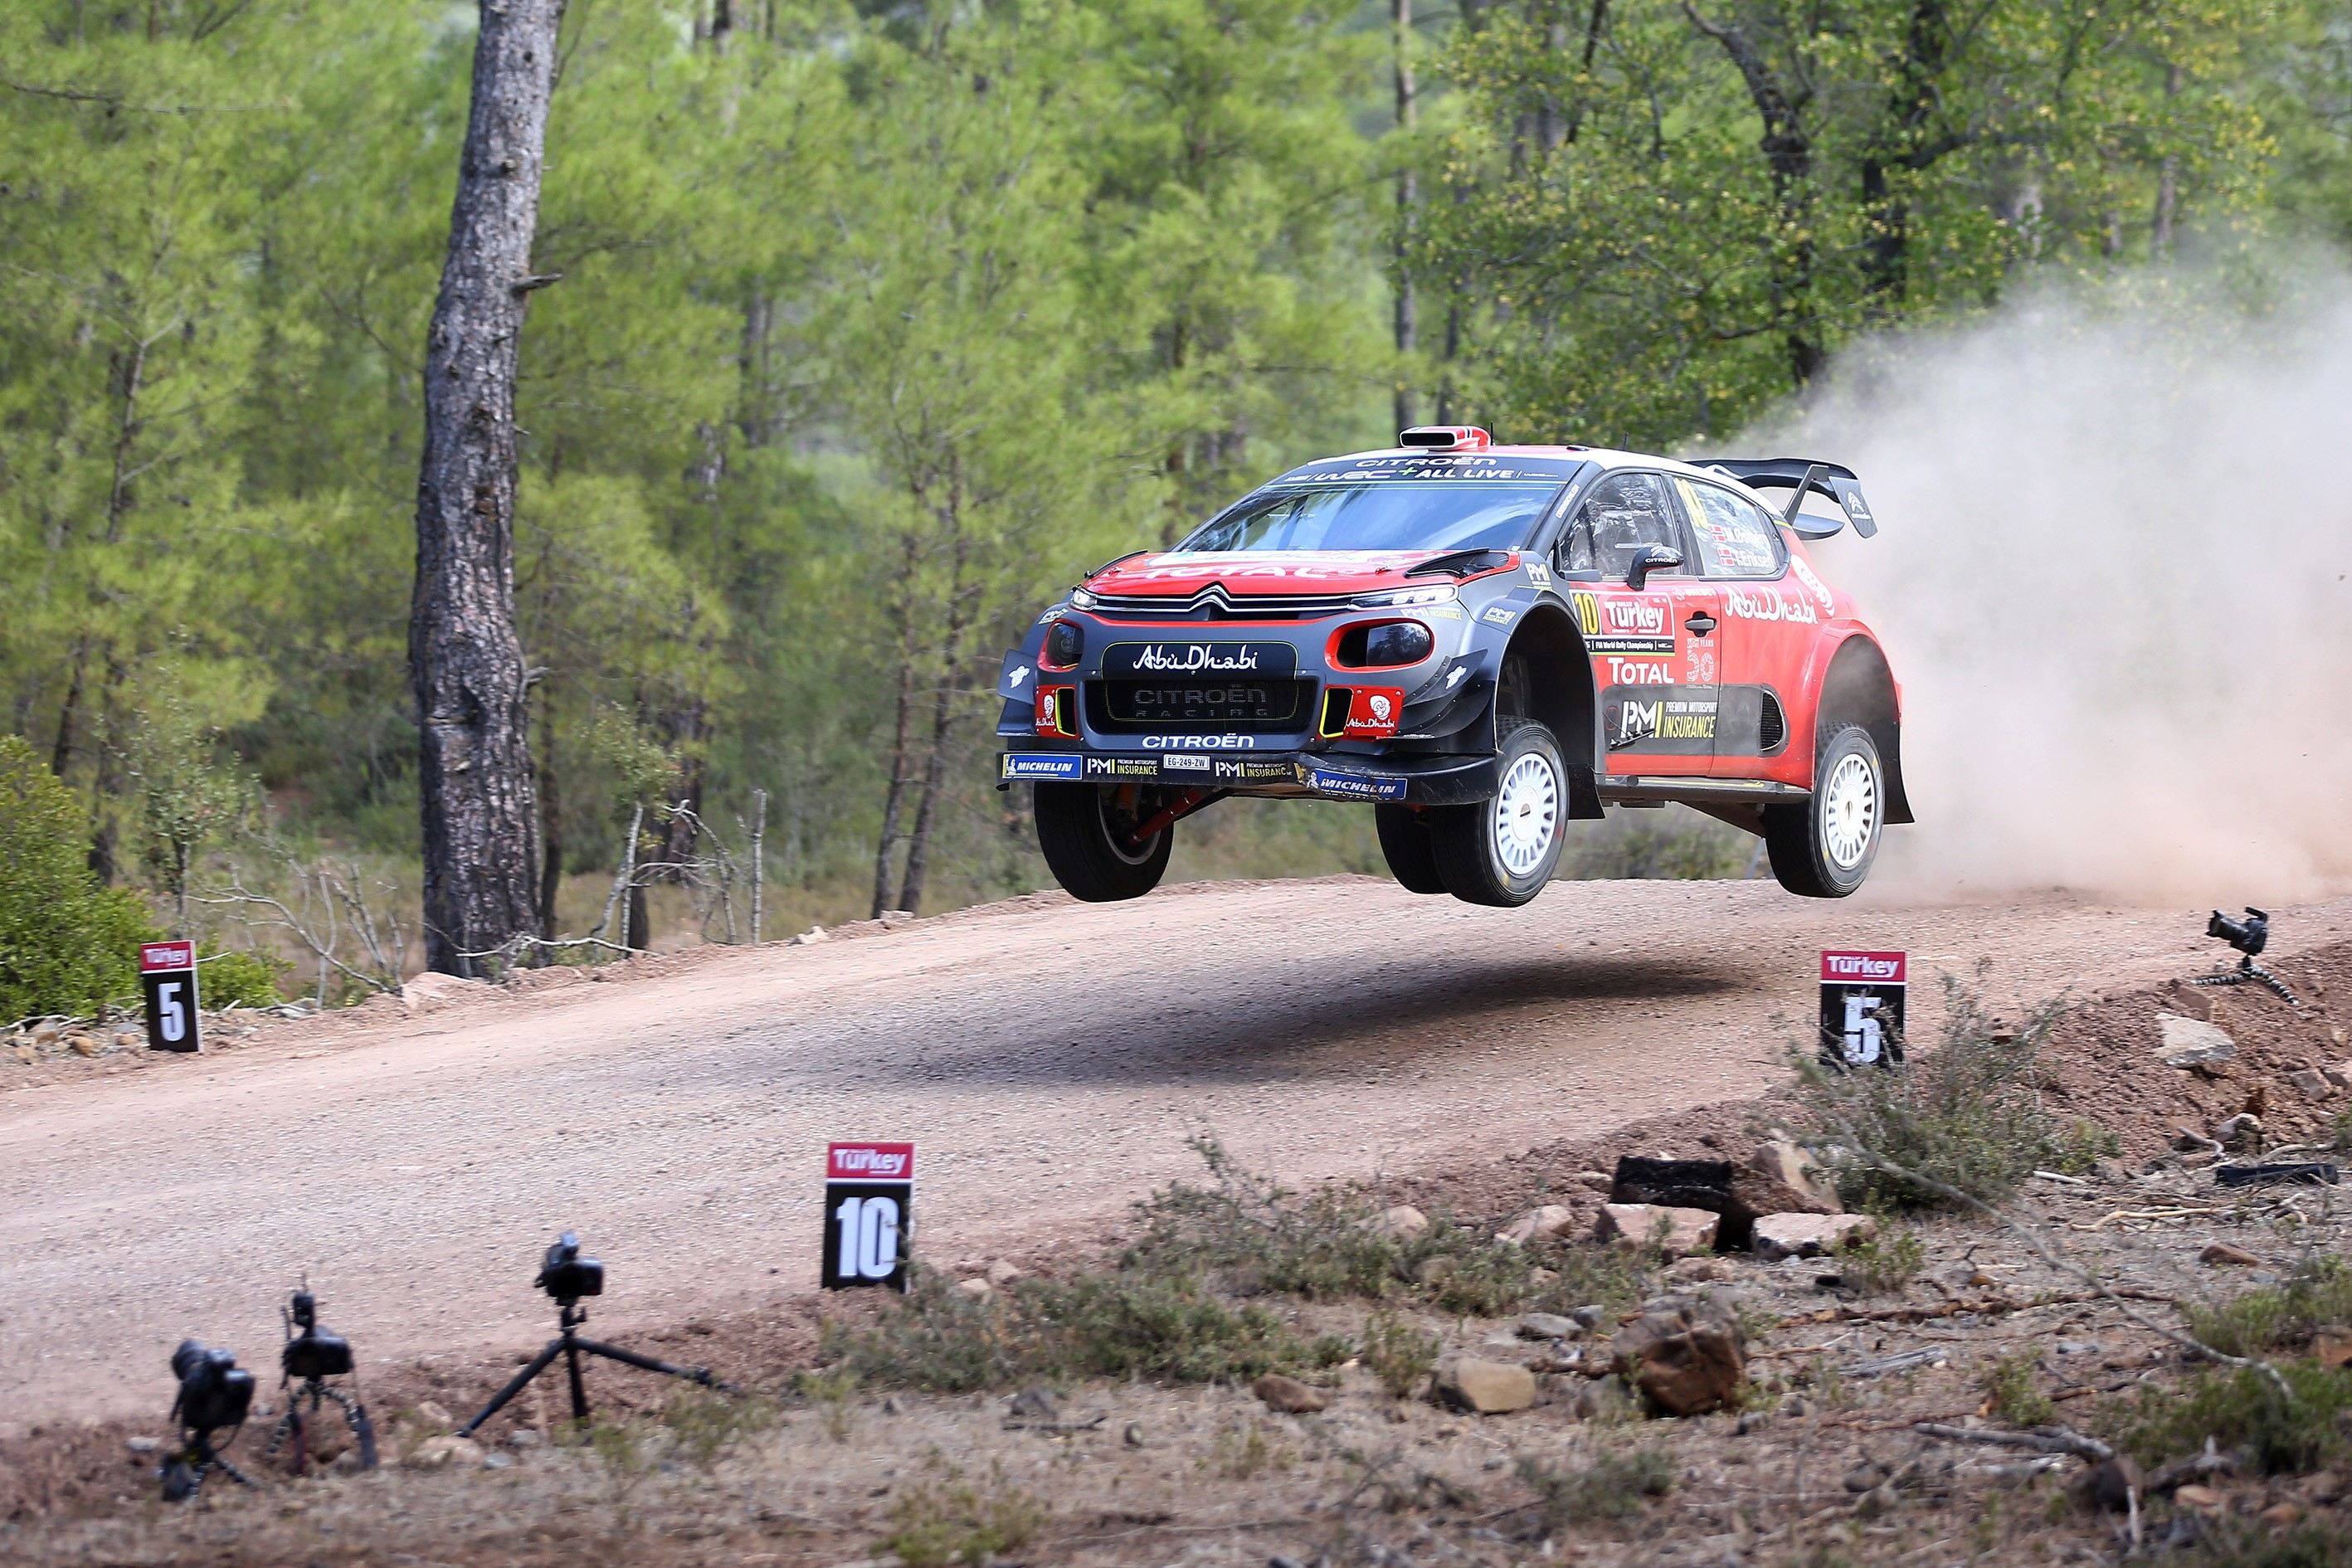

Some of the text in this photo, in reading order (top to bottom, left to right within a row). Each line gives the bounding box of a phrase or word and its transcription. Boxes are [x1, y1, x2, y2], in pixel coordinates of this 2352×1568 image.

[1414, 467, 1455, 479] ALL
[1463, 469, 1515, 480] LIVE
[1574, 593, 1600, 635] 10
[1604, 601, 1664, 634] Turkey
[1608, 657, 1675, 684] TOTAL
[1666, 701, 1717, 713] PREMIUM MOTORSPORT
[1620, 700, 1663, 738] PMI
[1663, 716, 1717, 738] INSURANCE
[1017, 762, 1074, 772] MICHELIN
[1087, 758, 1116, 774] PMI
[1118, 765, 1157, 776] INSURANCE
[1167, 757, 1205, 767] EG-249-ZW
[1215, 762, 1245, 777] PMI
[1827, 956, 1900, 978] Turkey
[158, 982, 186, 1041] 5
[1843, 996, 1882, 1063] 5
[834, 1148, 908, 1175] Turkey
[836, 1196, 899, 1278] 10
